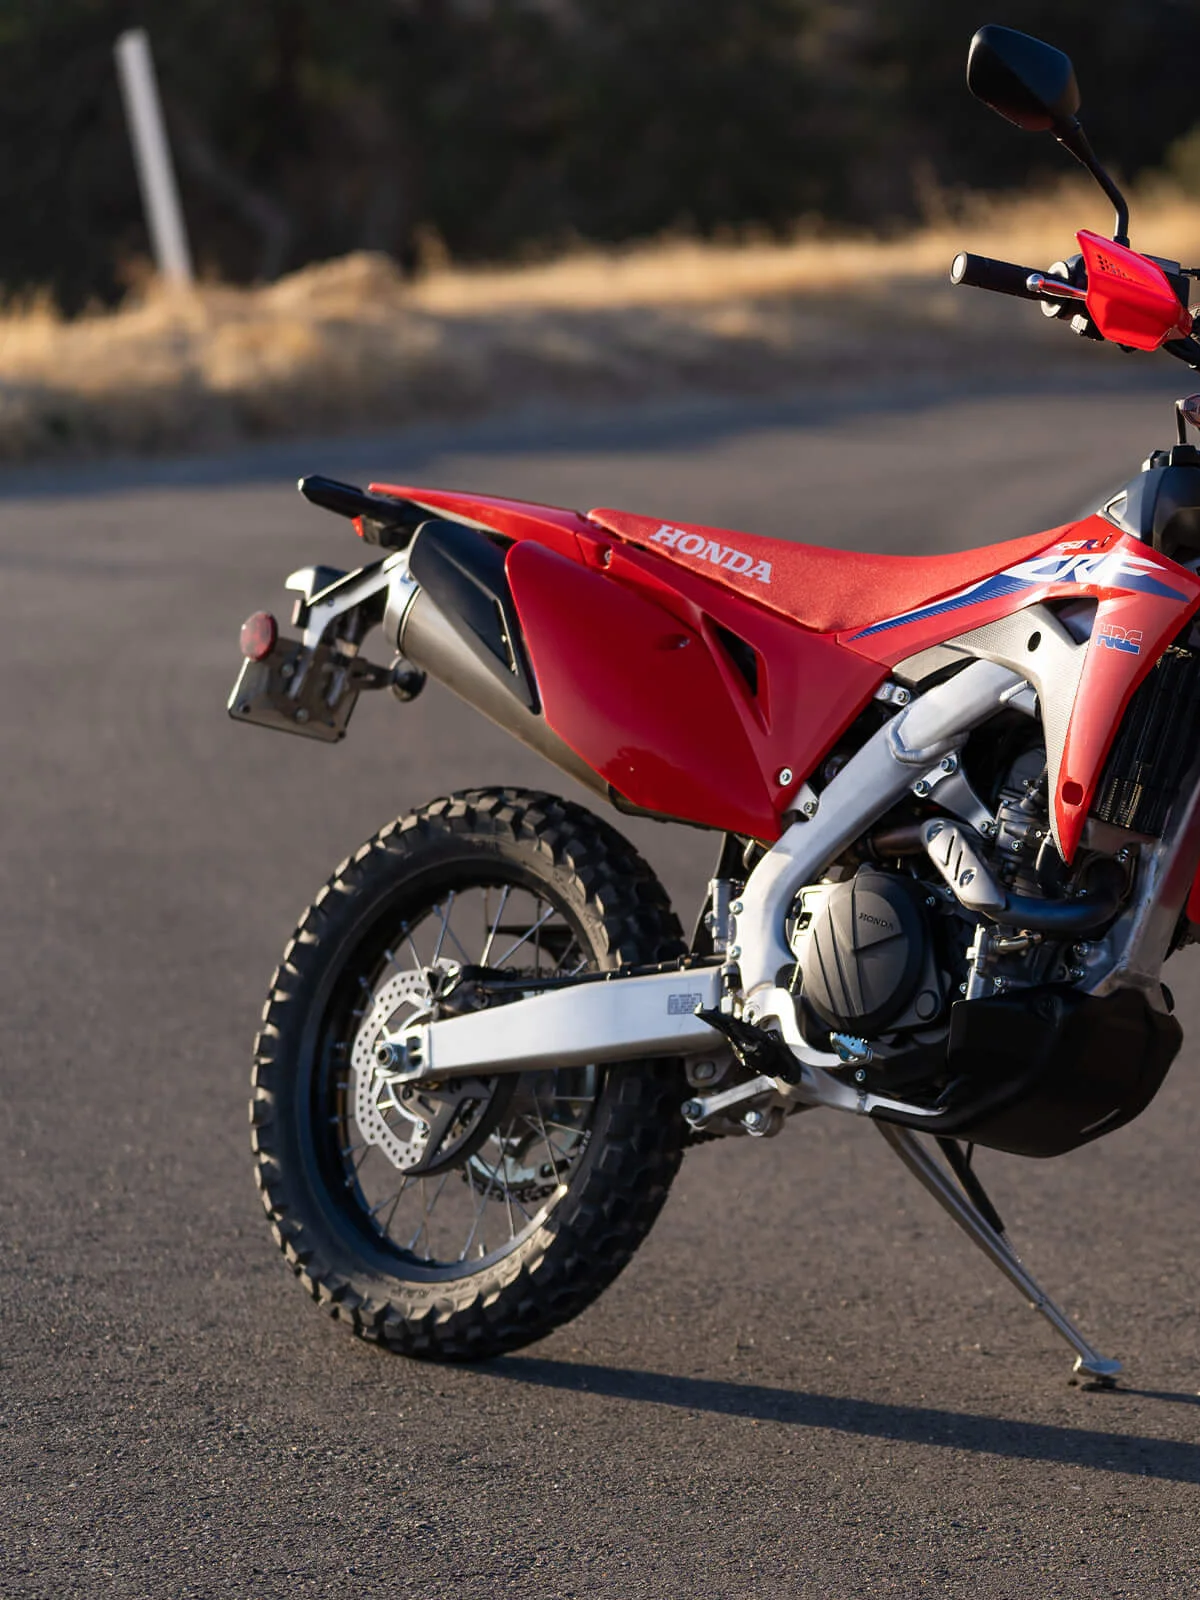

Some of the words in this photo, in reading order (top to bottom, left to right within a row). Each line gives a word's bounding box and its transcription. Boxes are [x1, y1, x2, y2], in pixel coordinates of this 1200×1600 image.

[650, 524, 772, 585] HONDA
[1001, 549, 1168, 584] CRF
[1096, 622, 1143, 655] HRC
[858, 912, 894, 931] HONDA
